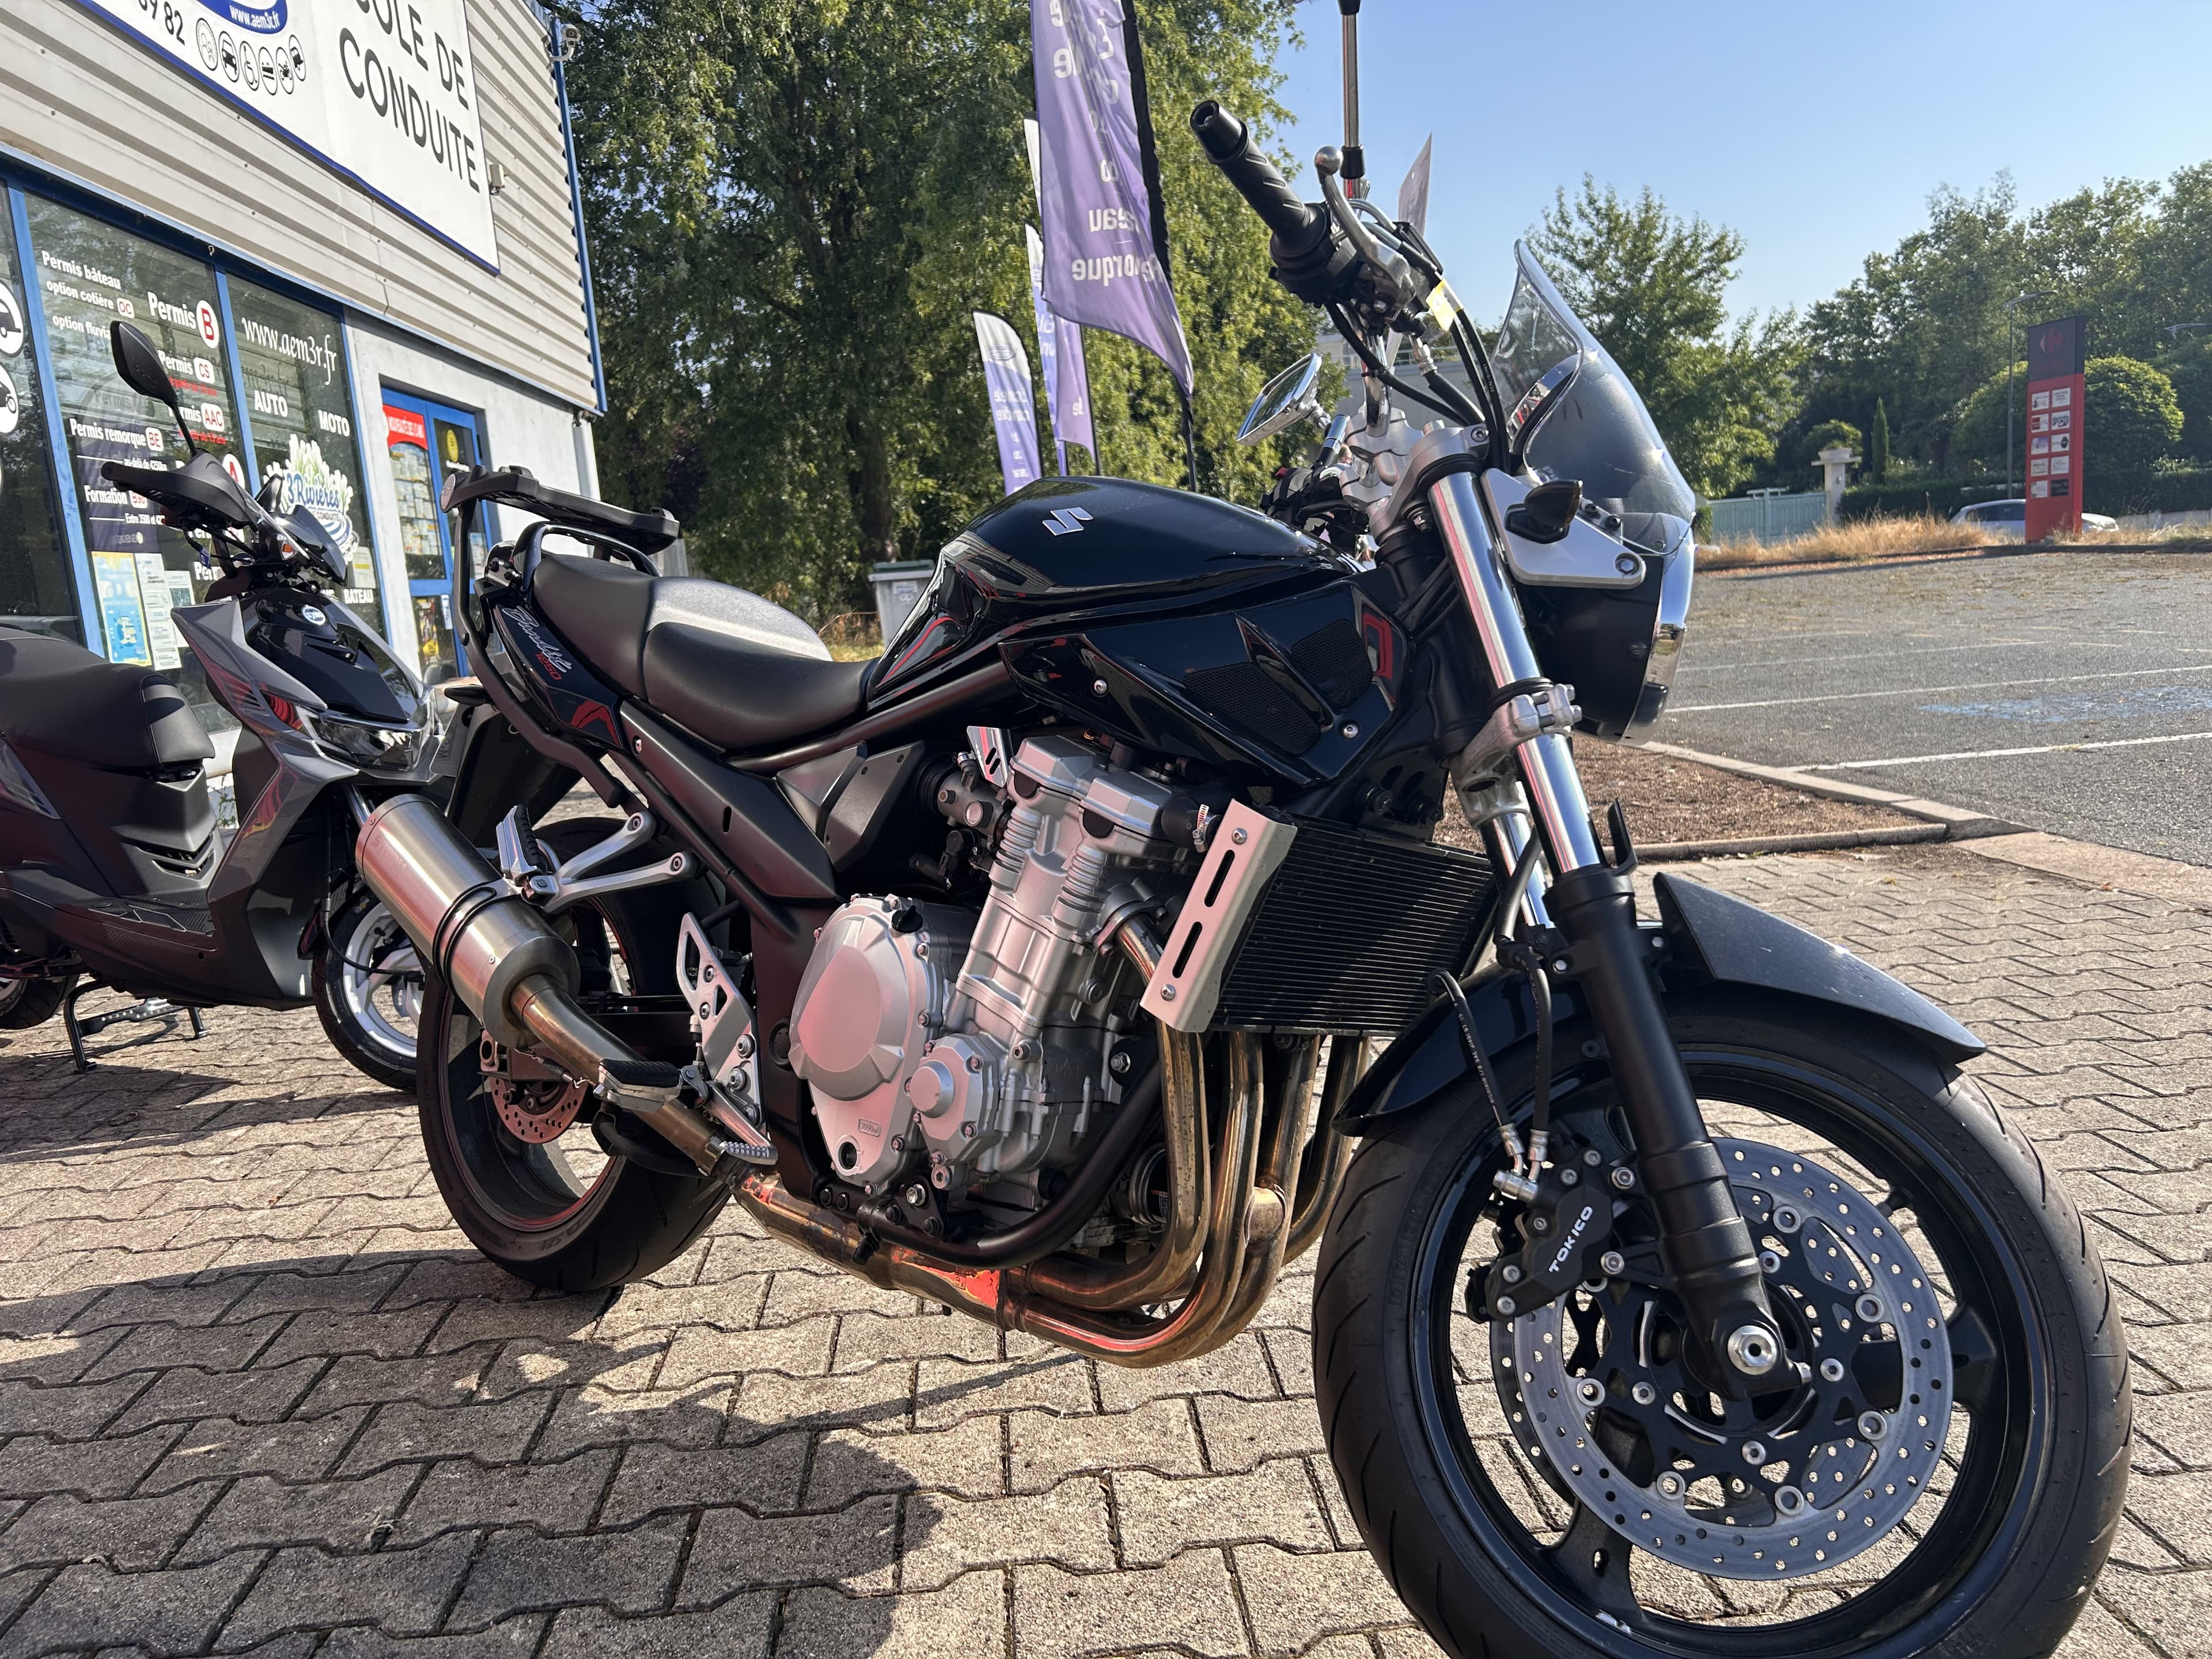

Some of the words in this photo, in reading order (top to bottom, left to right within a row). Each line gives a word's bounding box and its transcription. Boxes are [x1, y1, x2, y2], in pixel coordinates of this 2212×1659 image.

[164, 1, 185, 46] 82
[229, 5, 280, 29] www.aem3r.fr
[355, 0, 428, 71] OLE
[434, 31, 469, 111] DE
[339, 28, 480, 193] CONDUITE
[41, 250, 82, 277] Permis
[84, 264, 121, 289] bâteau
[46, 281, 78, 299] option
[80, 290, 114, 309] cotière
[119, 301, 132, 315] OC
[52, 315, 84, 332] option
[86, 321, 111, 340] fluvia
[147, 291, 196, 329] Permis
[201, 308, 214, 340] B
[157, 350, 194, 374] Permis
[199, 363, 210, 378] CS
[241, 317, 336, 385] www.aem3r.fr
[168, 405, 202, 422] rmis
[204, 409, 222, 427] AAC
[254, 390, 288, 418] AUTO
[69, 418, 104, 440] Permis
[105, 428, 146, 449] remorque
[148, 433, 161, 448] BE
[318, 410, 350, 437] MOTO
[84, 485, 128, 505] Formation
[287, 473, 294, 504] 3
[125, 513, 139, 524] Entre
[343, 589, 374, 604] BATEAU
[502, 605, 572, 673] Bandit
[535, 653, 562, 680] 1250
[1548, 1206, 1593, 1272] TOKICO
